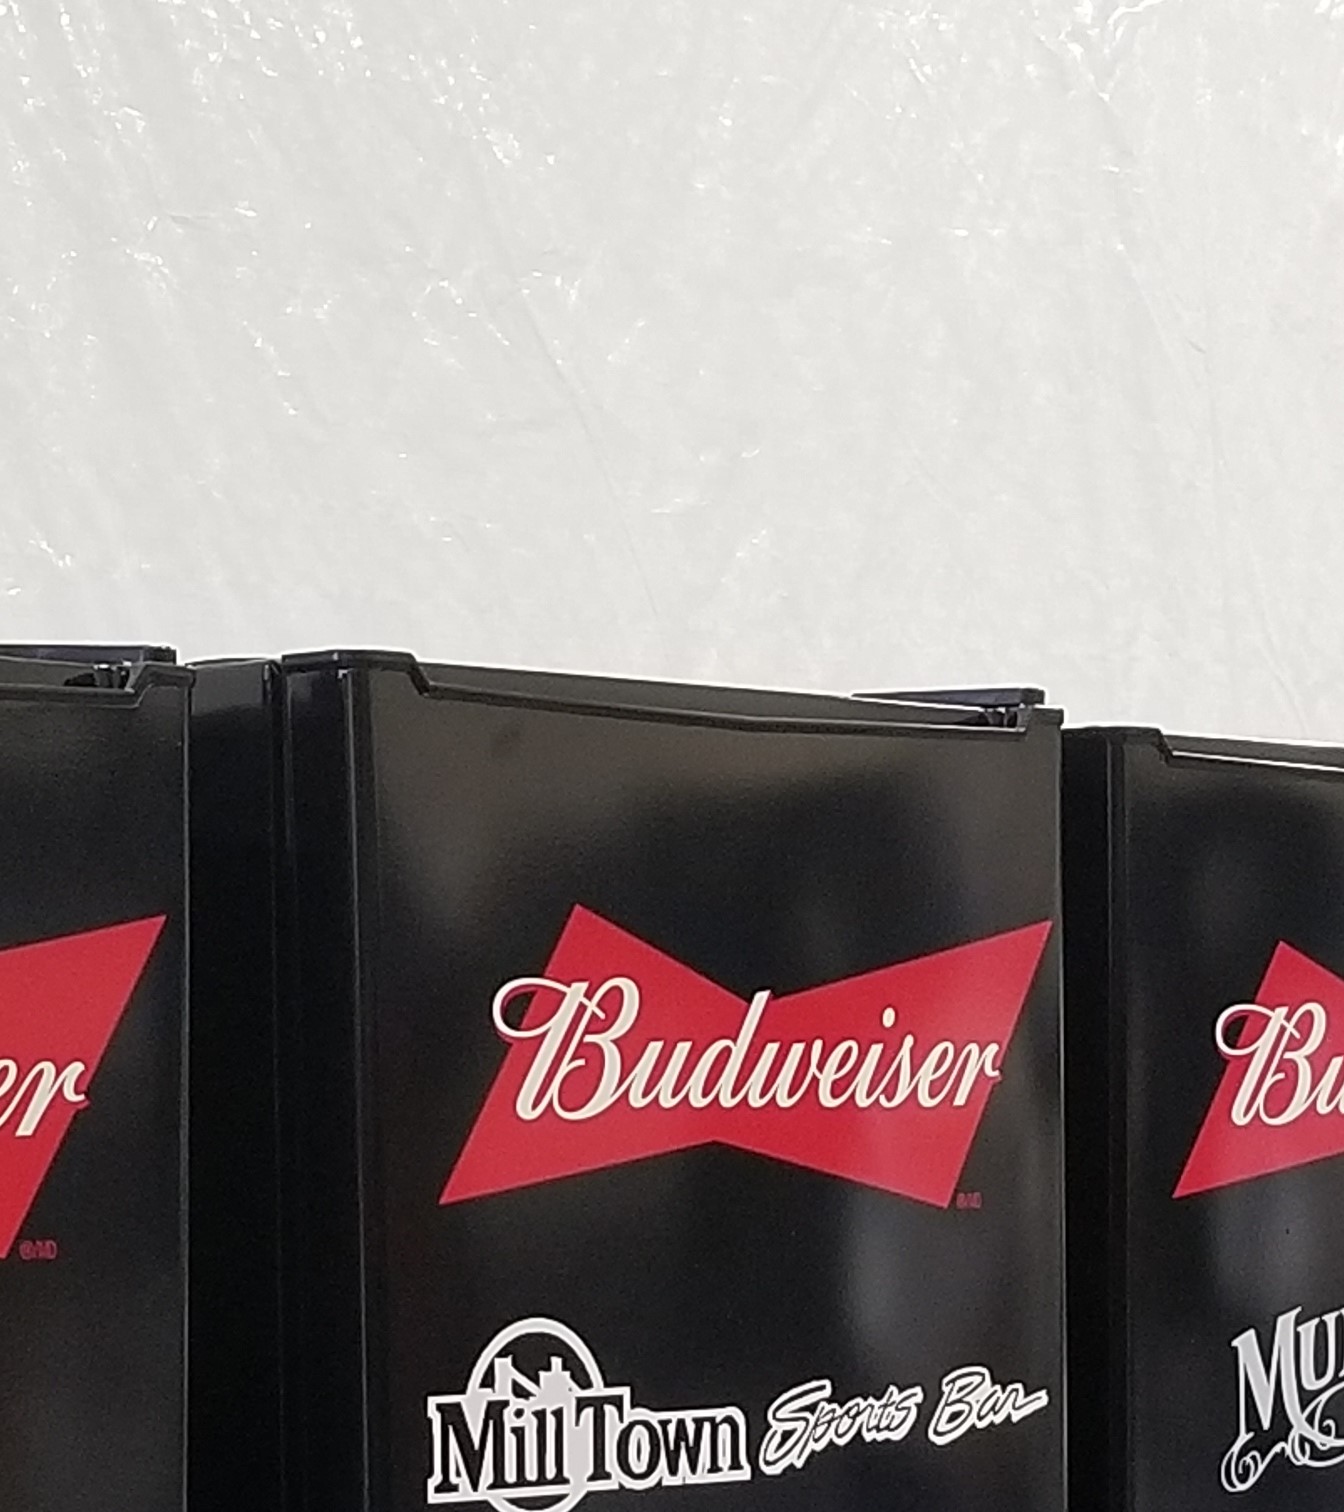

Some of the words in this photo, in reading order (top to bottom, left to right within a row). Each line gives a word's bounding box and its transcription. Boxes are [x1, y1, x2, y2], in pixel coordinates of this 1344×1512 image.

[492, 976, 1001, 1121] Budweiser
[759, 1379, 924, 1476] Sports
[928, 1366, 1049, 1446] Bar
